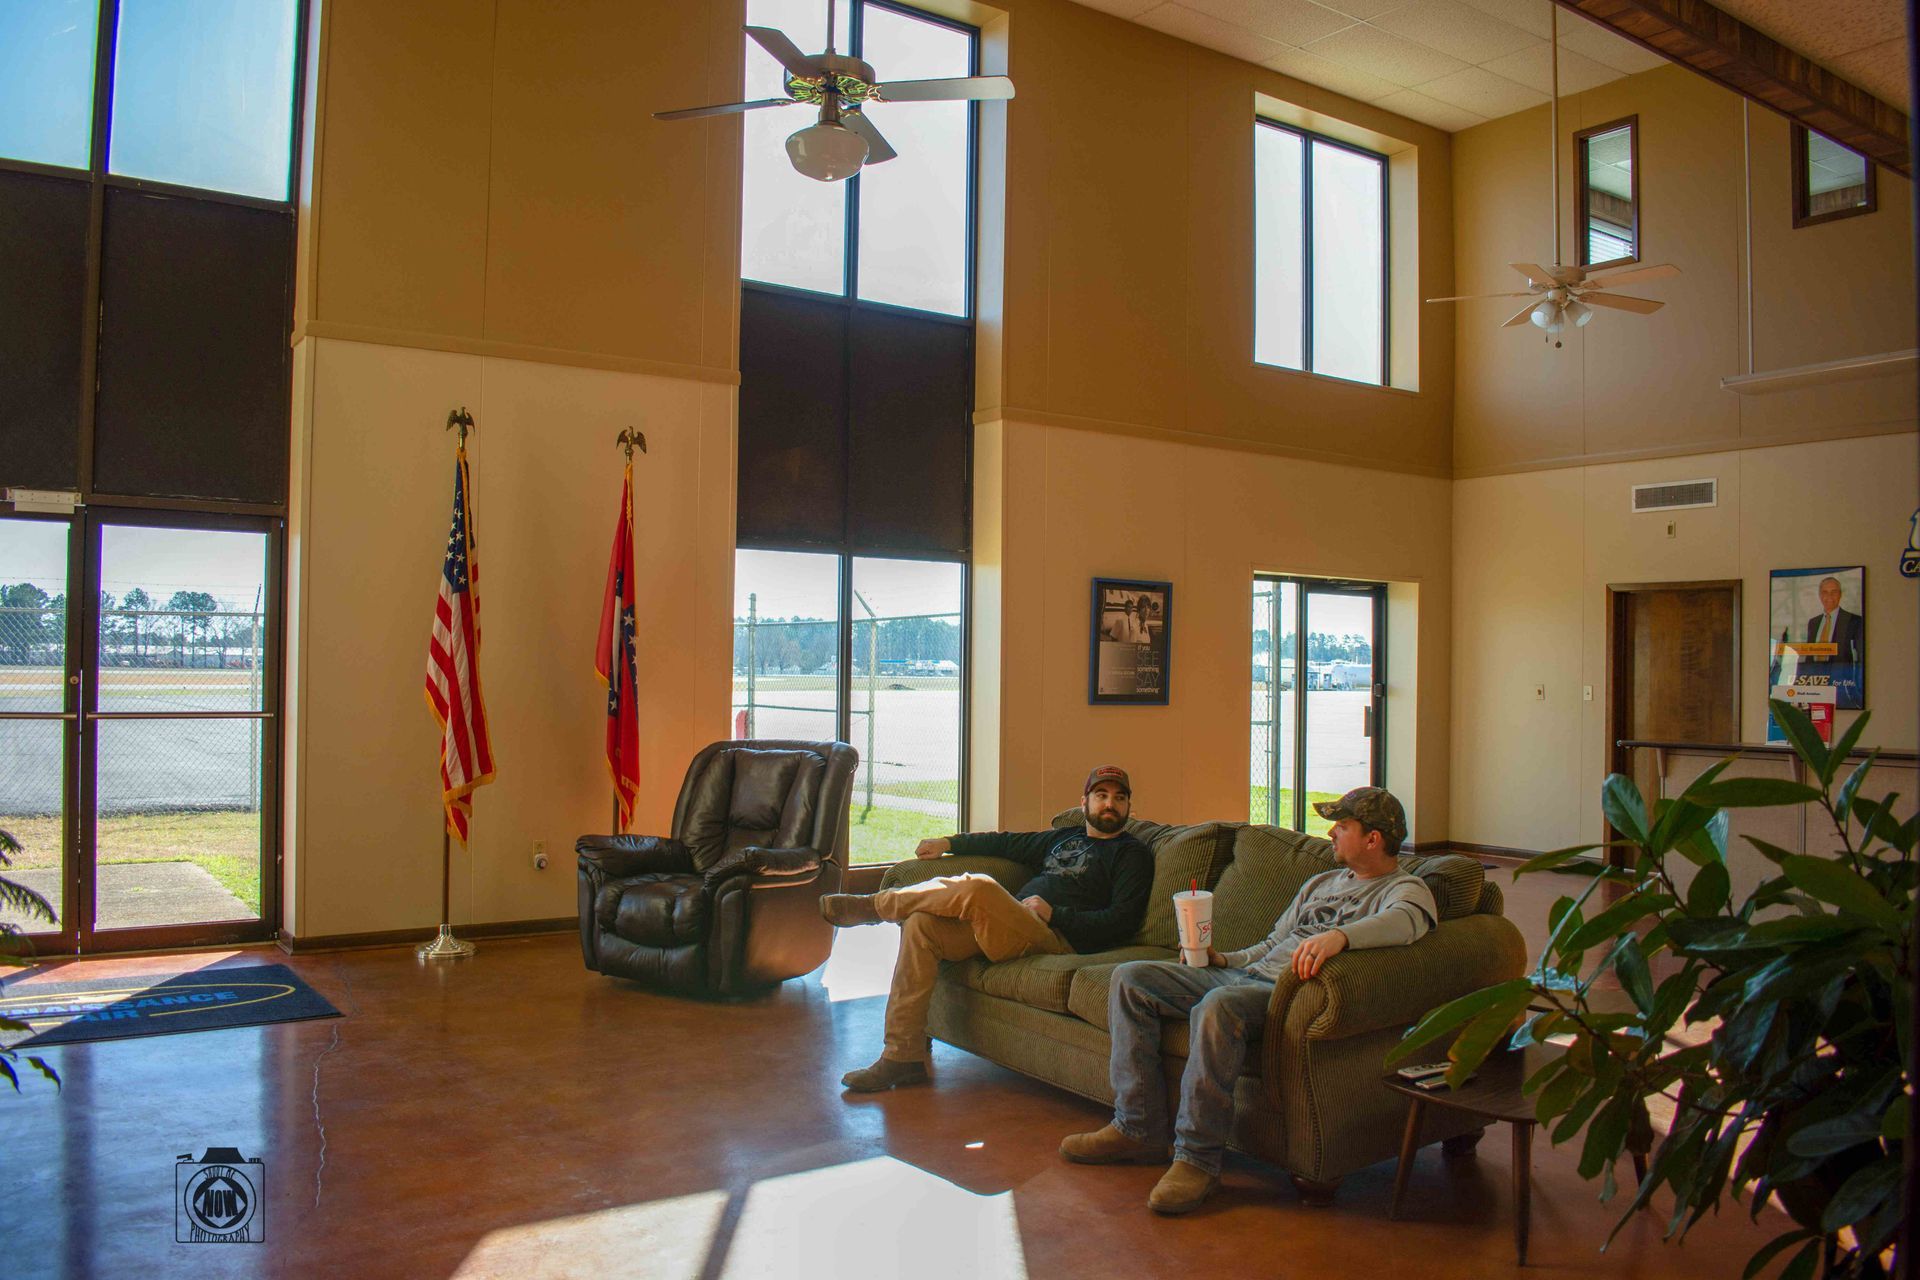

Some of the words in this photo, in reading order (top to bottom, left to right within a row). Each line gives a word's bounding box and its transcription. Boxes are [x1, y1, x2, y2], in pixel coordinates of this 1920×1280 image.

[1136, 651, 1159, 666] SEE
[1136, 672, 1160, 687] SAY
[71, 1009, 140, 1024] AIR
